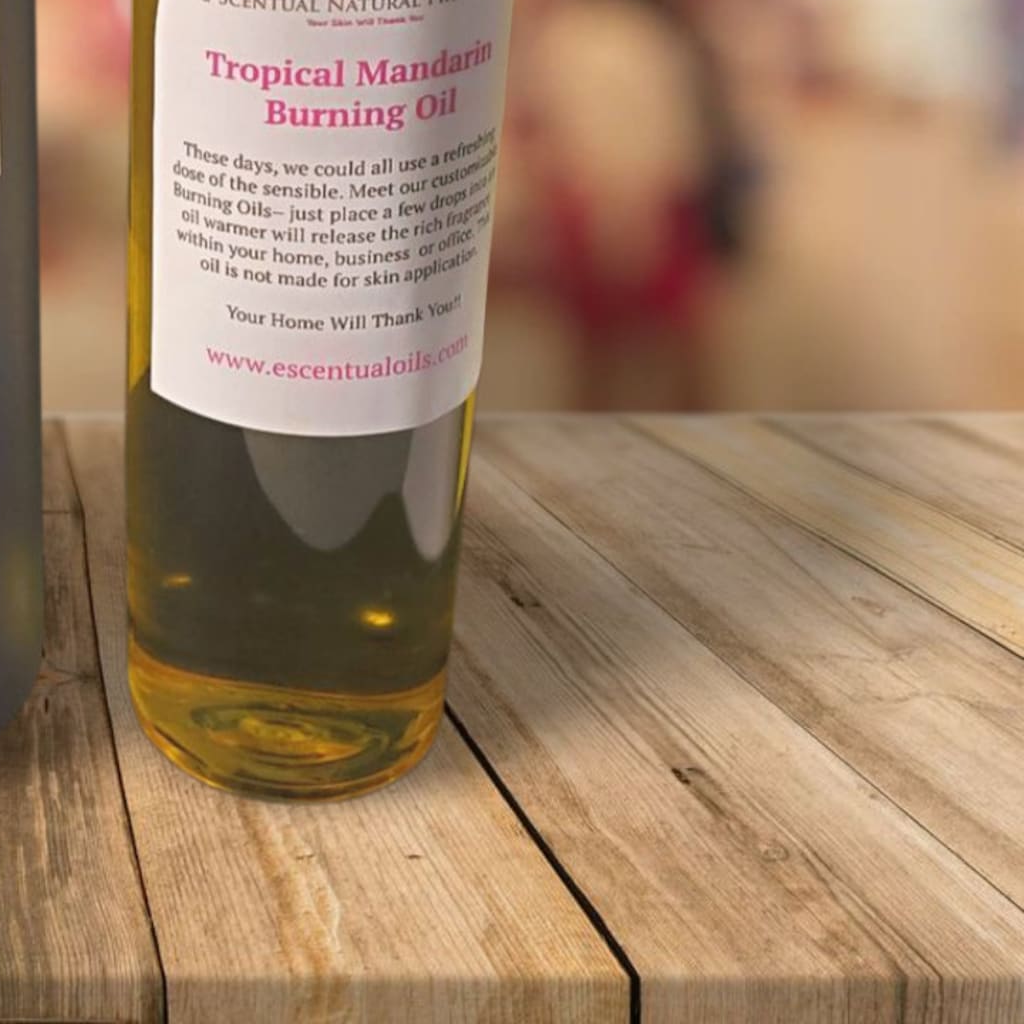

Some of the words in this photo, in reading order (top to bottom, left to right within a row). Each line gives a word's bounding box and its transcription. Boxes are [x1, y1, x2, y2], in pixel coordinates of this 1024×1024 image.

[205, 49, 344, 90] Tropical
[356, 39, 493, 87] Mandarin
[264, 99, 407, 131] Burning
[415, 86, 457, 121] Oil
[183, 141, 229, 168] These
[233, 153, 278, 176] days,
[282, 163, 309, 177] we
[314, 160, 366, 177] could
[371, 159, 393, 176] all
[398, 157, 427, 173] use
[430, 153, 440, 168] a
[173, 161, 205, 183] dose
[208, 171, 226, 187] of
[229, 175, 258, 195] the
[262, 182, 344, 200] sensible.
[348, 183, 394, 199] Meet
[399, 179, 427, 195] our
[173, 181, 233, 215] Burning
[288, 206, 325, 224] just
[329, 206, 378, 225] place
[382, 206, 393, 220] a
[398, 198, 426, 218] few
[430, 188, 467, 213] drops
[181, 209, 200, 226] oil
[203, 214, 268, 240] warmer
[272, 225, 305, 243] will
[310, 226, 376, 244] release
[381, 223, 410, 241] the
[413, 214, 443, 236] rich
[177, 228, 224, 253] within
[228, 241, 267, 262] your
[272, 249, 329, 268] home,
[334, 247, 410, 266] business
[418, 239, 437, 257] or
[200, 257, 220, 274] oil
[224, 261, 239, 278] is
[243, 267, 272, 283] not
[277, 269, 328, 288] made
[332, 270, 360, 288] for
[363, 267, 400, 286] skin
[226, 304, 265, 326] Your
[270, 311, 325, 331] Home
[330, 311, 367, 330] Will
[371, 307, 425, 329] Thank
[205, 333, 470, 381] www.escentualoils.com
